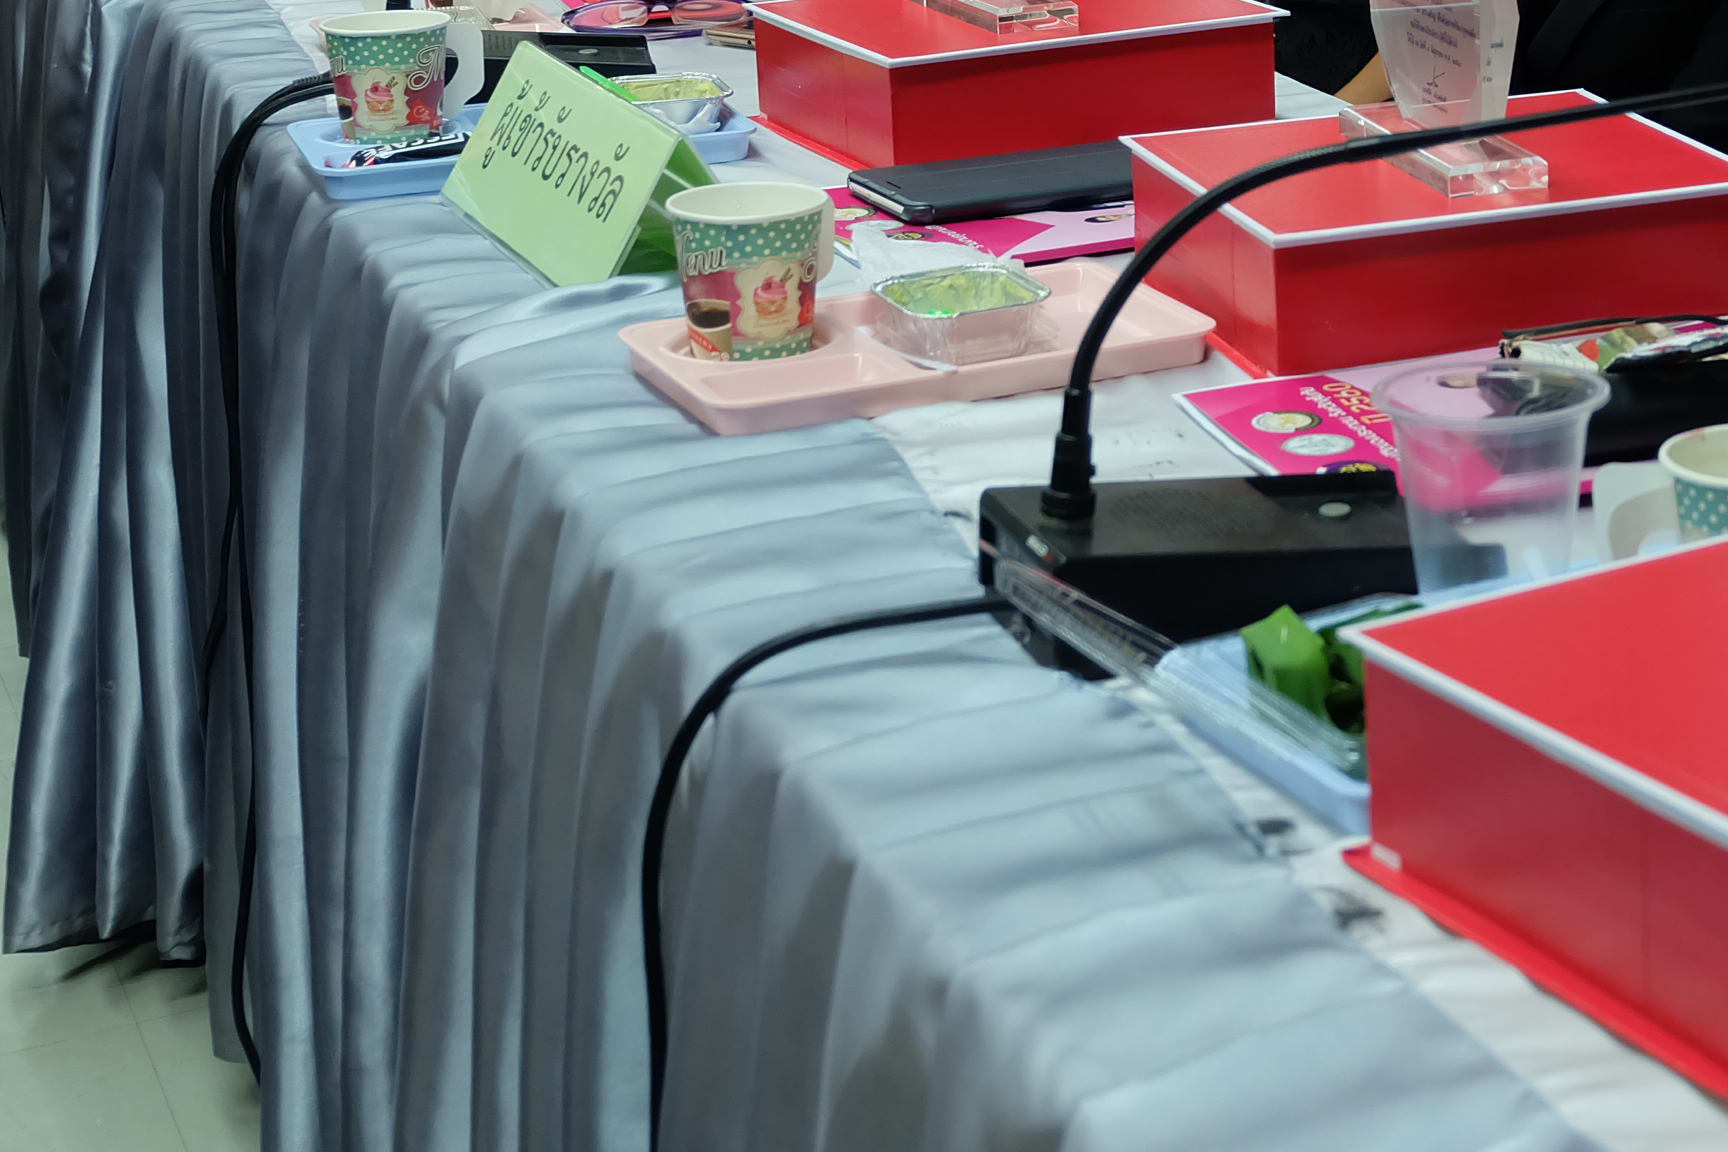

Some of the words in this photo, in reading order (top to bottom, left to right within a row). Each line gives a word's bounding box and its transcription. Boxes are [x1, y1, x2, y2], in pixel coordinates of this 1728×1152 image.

[482, 79, 631, 223] ผู้เข้ารับรางวัล
